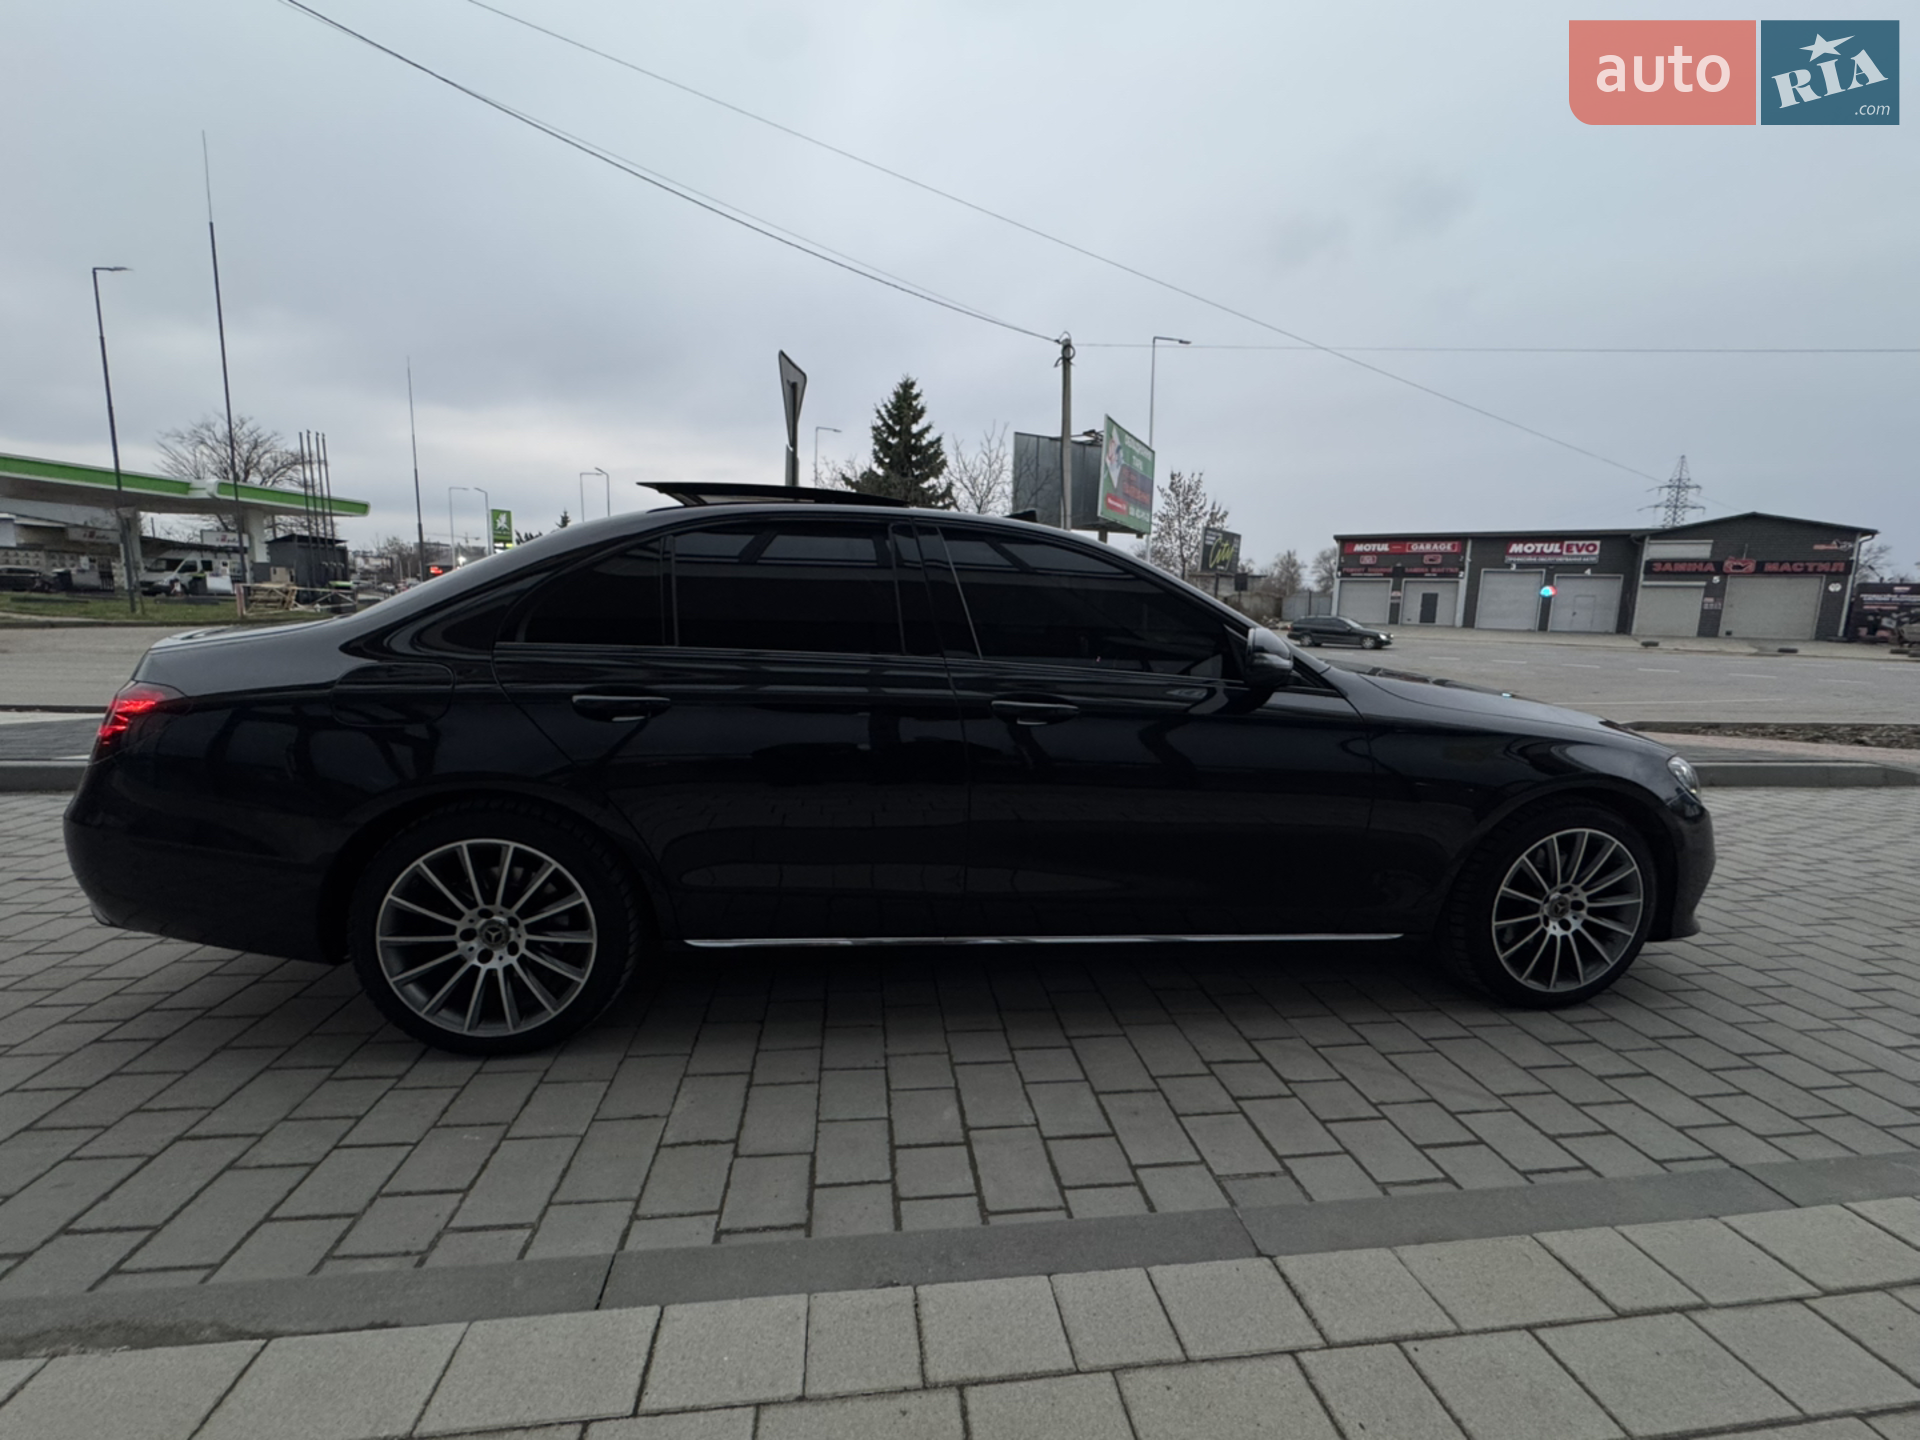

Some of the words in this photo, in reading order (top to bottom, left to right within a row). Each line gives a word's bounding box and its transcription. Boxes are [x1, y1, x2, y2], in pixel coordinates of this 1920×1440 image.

[1353, 543, 1389, 552] MOTUL
[1410, 543, 1452, 551] GARAGE
[1509, 543, 1561, 553] MOTUL
[1566, 543, 1598, 553] EVO
[1652, 562, 1715, 572] ЗАМІНА
[1763, 562, 1845, 572] МАСТИЛ
[1712, 576, 1720, 584] 5
